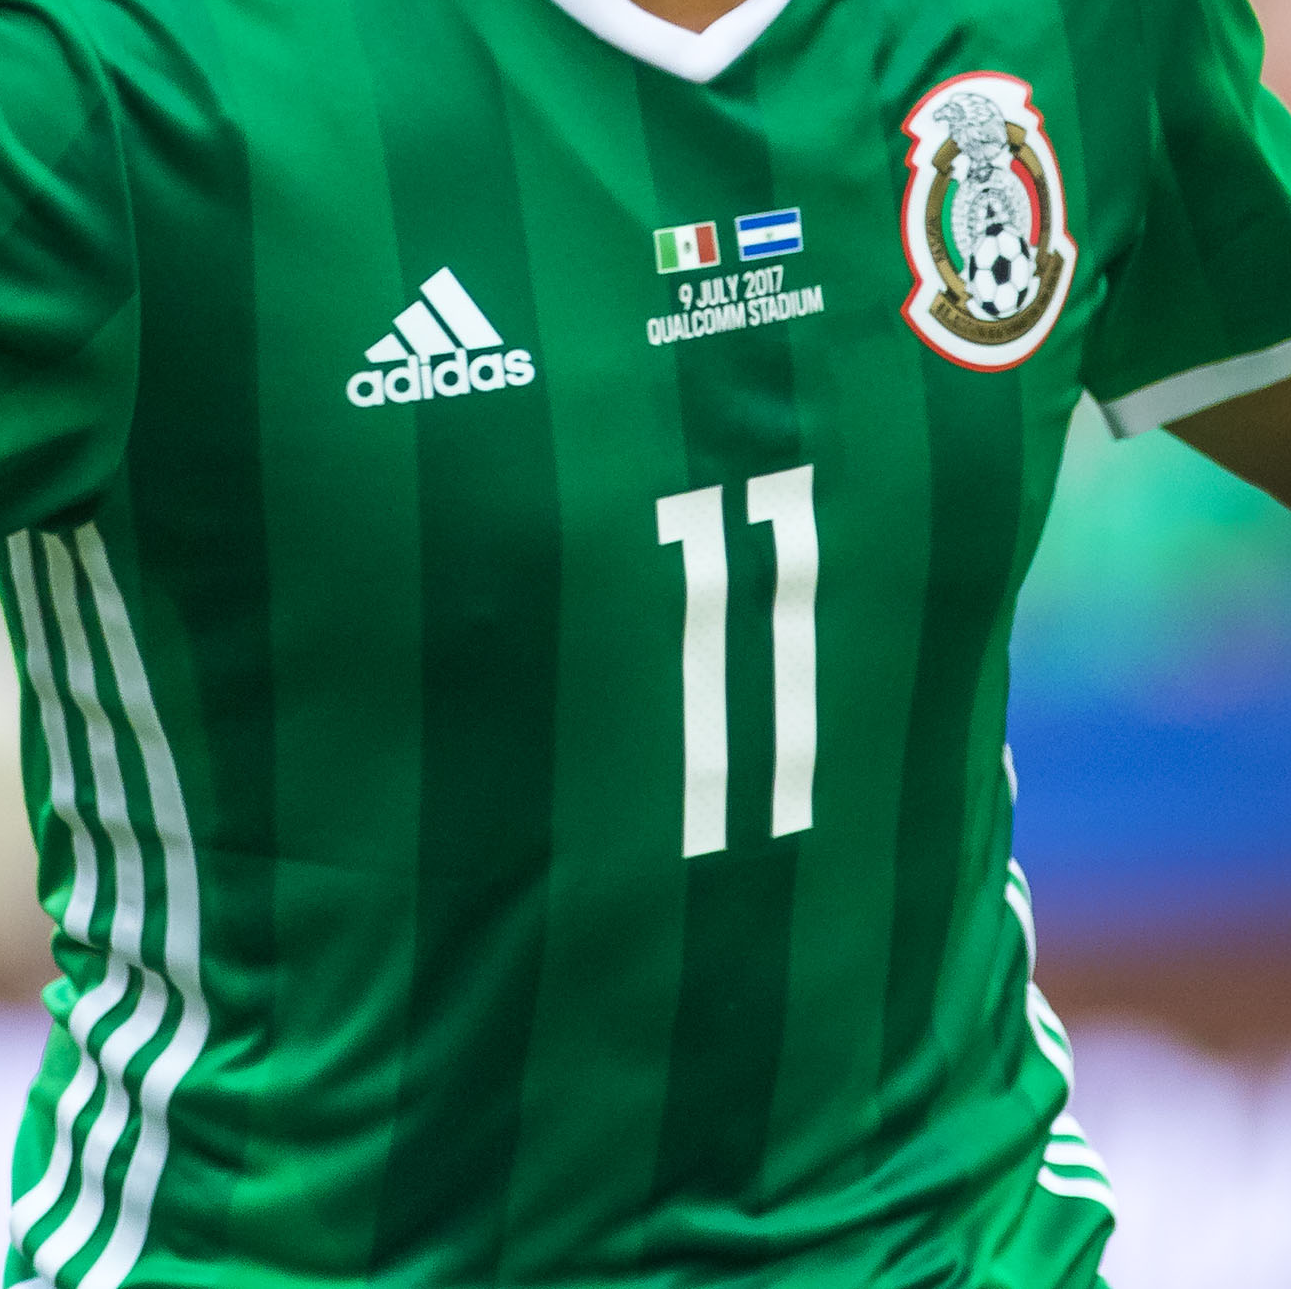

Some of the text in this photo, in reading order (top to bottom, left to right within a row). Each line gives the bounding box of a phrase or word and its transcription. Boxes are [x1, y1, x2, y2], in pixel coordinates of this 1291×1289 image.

[646, 286, 824, 346] QUALCOMM STADIUM
[678, 264, 784, 311] 9 JULY 2017
[346, 348, 536, 408] adidas
[656, 463, 819, 859] 11
